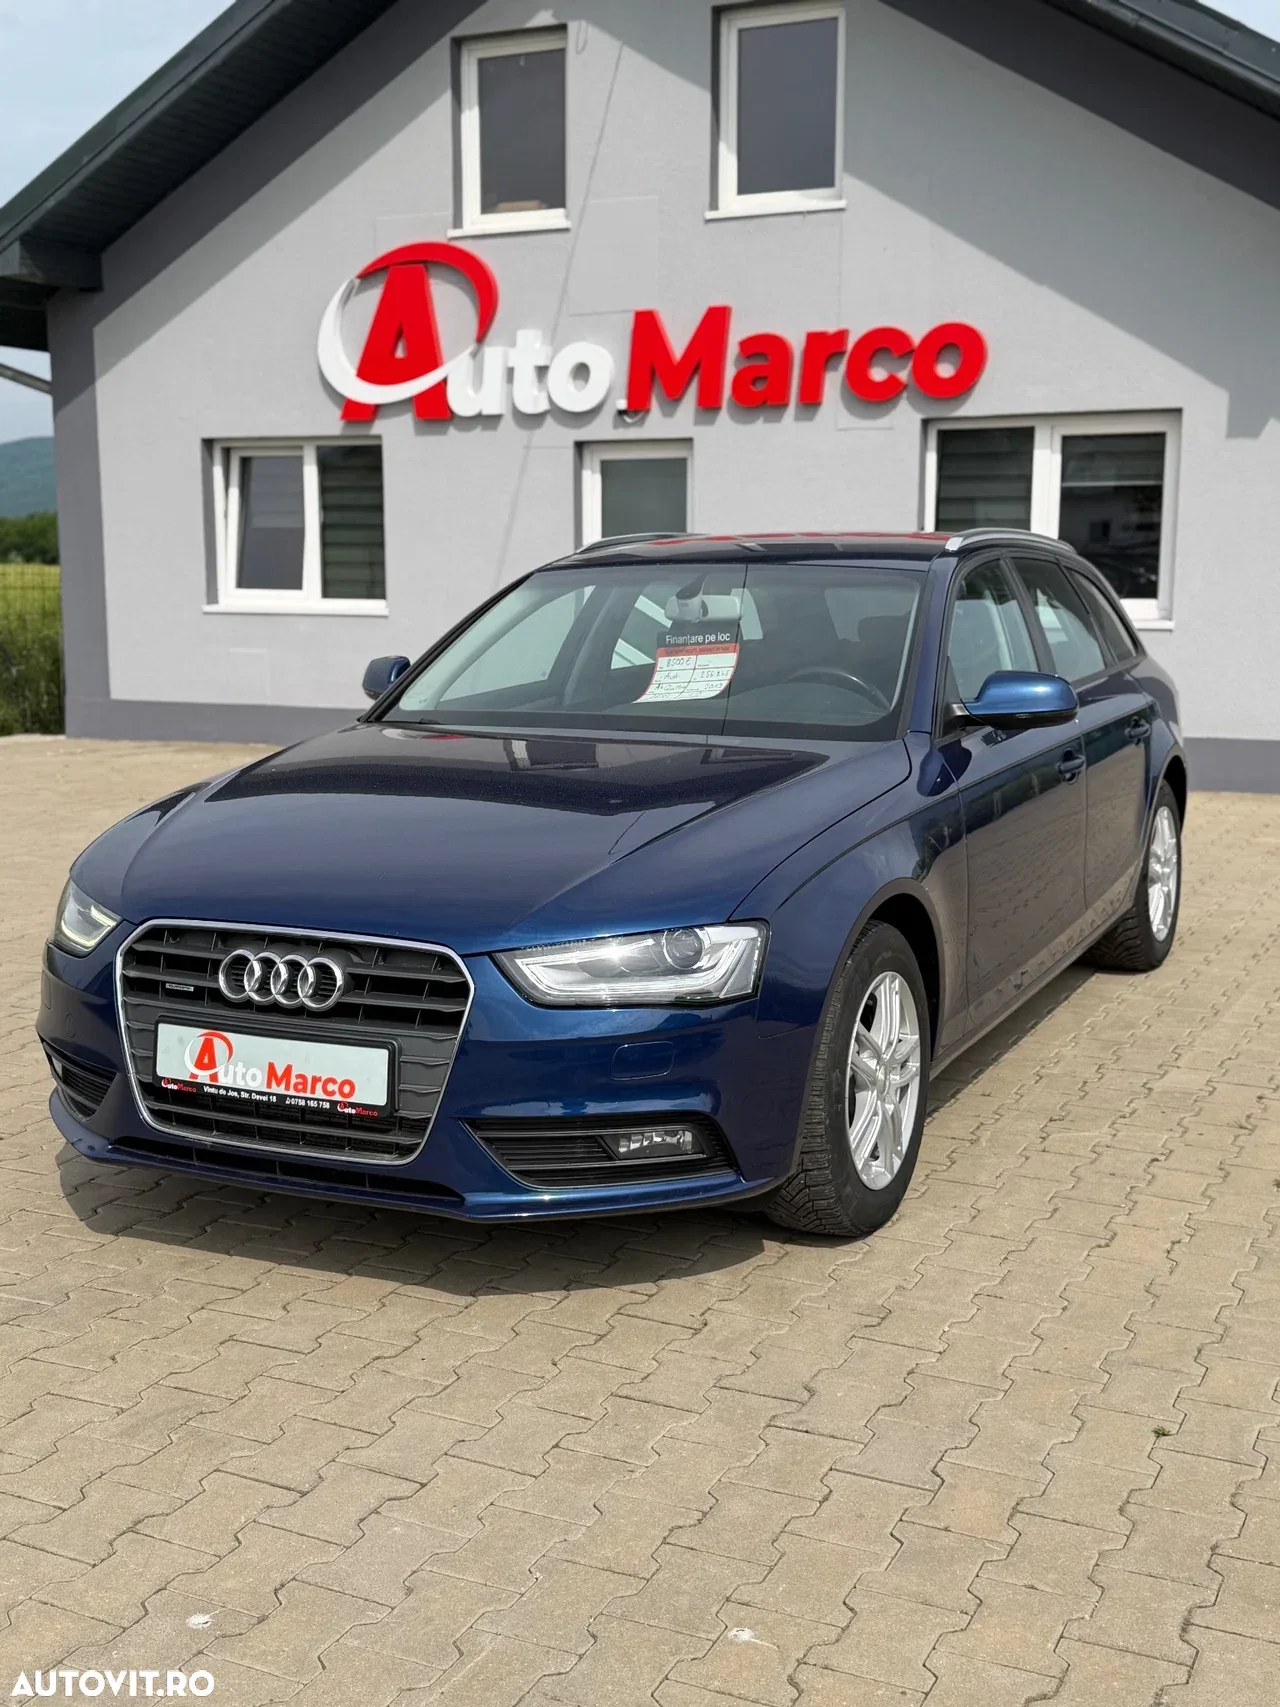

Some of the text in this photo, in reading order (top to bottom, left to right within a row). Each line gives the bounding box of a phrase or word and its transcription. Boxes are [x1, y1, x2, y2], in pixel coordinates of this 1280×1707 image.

[320, 245, 989, 421] Auto Marco
[705, 634, 717, 644] pe
[717, 631, 731, 641] loc
[185, 1031, 357, 1099] Auto Marco
